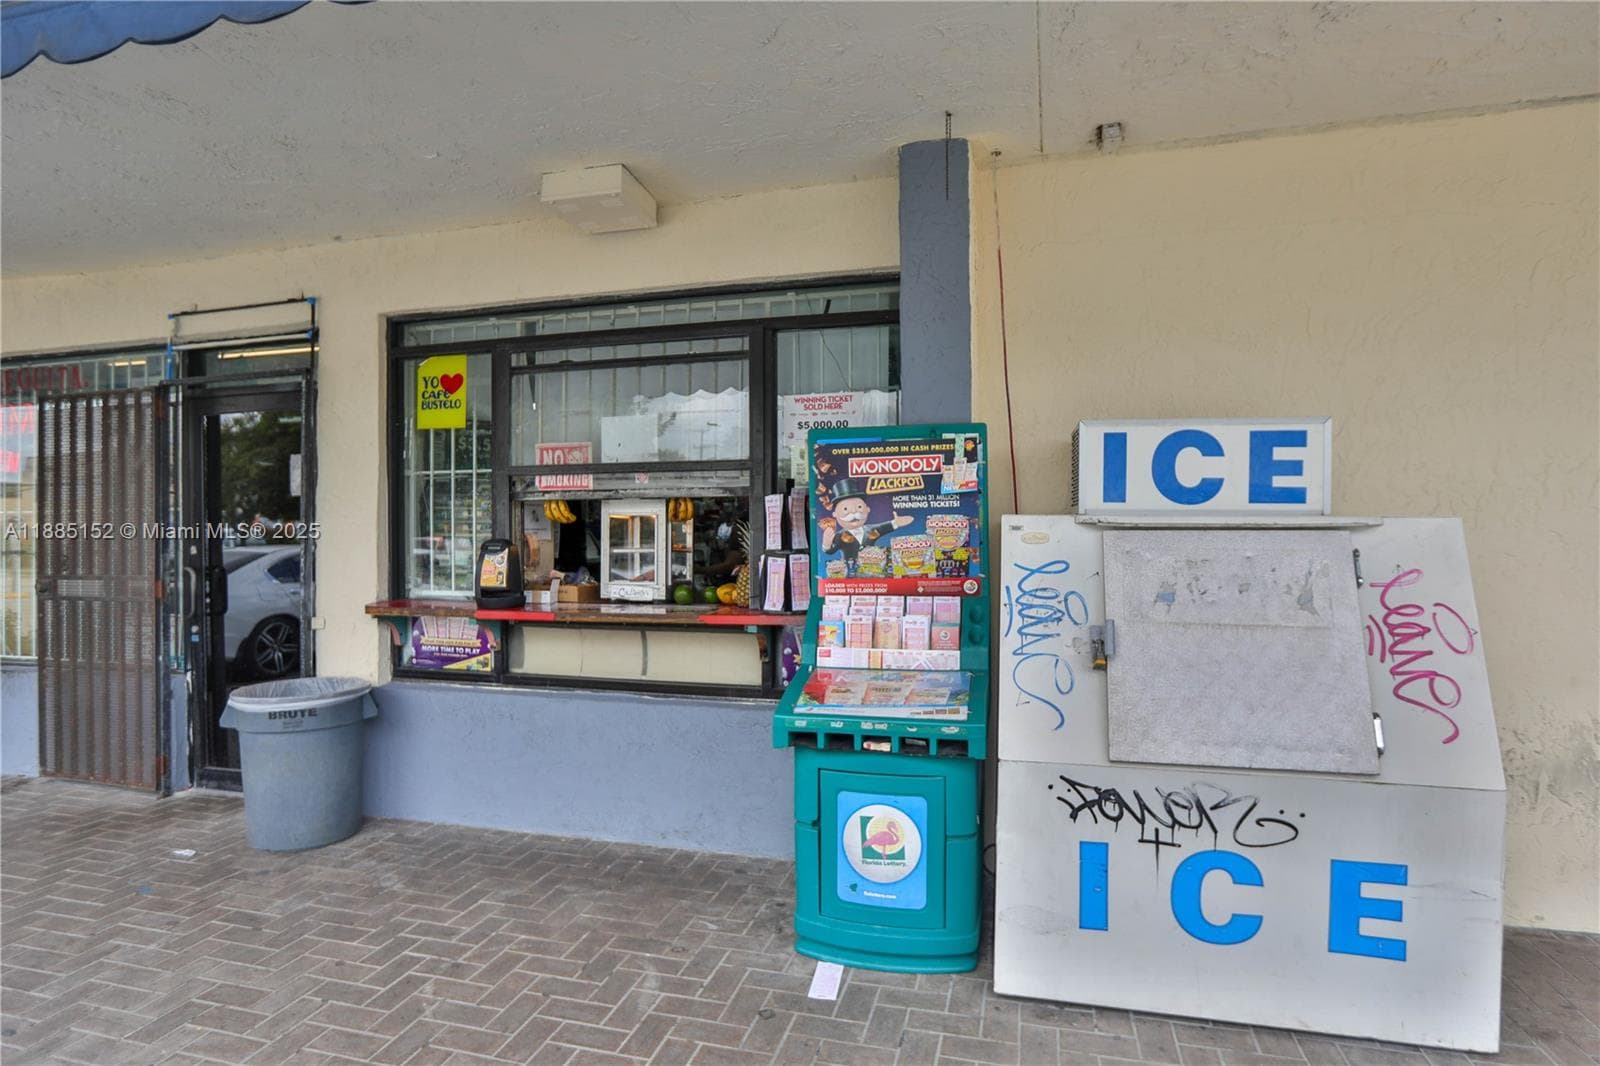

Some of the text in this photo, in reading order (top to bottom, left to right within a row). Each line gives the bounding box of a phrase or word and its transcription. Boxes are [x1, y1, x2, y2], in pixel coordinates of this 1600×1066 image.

[423, 376, 439, 389] YO
[421, 399, 461, 410] BUSTELO
[827, 394, 853, 403] TICKET
[910, 444, 929, 452] CASH
[543, 449, 564, 465] NO
[852, 458, 940, 474] MONOPOLY
[1103, 429, 1307, 505] ICE
[541, 473, 588, 487] SMOKING
[871, 477, 921, 490] JACKPOT
[892, 500, 960, 509] WINNING TICKETS!
[421, 644, 439, 652] MORE
[465, 647, 481, 655] PLAY
[268, 707, 318, 720] BRUTE
[1079, 840, 1408, 962] ICE
